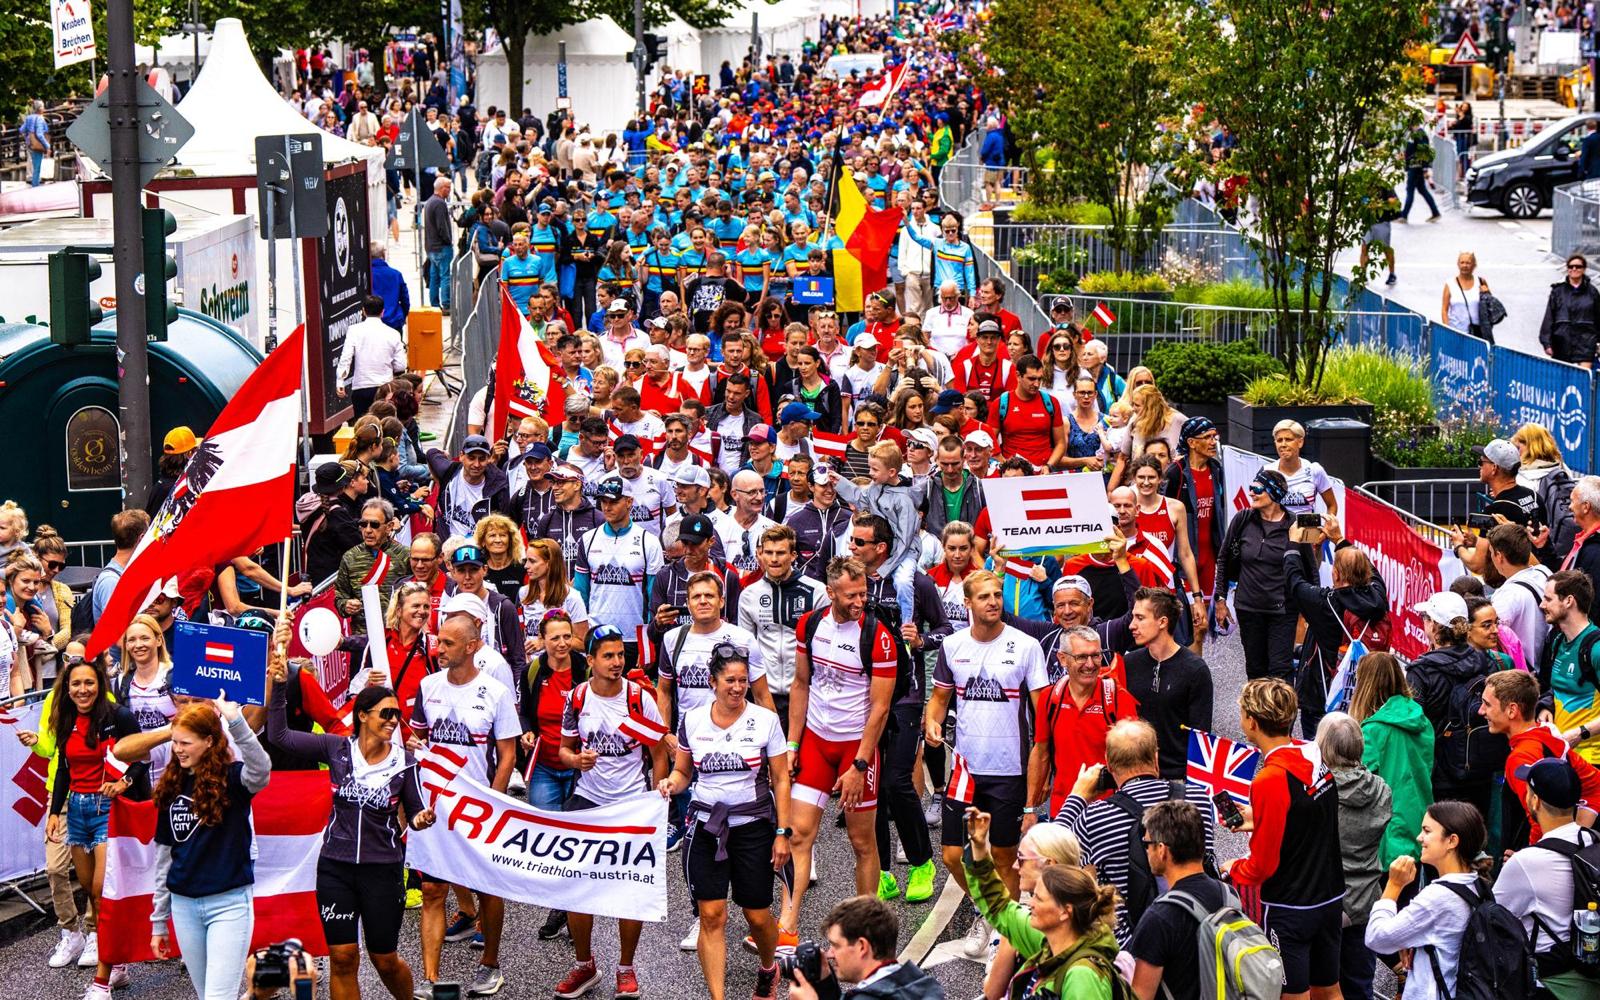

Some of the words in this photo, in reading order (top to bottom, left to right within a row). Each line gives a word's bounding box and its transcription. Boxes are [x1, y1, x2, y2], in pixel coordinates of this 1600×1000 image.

[1197, 508, 1211, 518] AUT
[1002, 527, 1041, 536] TEAM
[1045, 523, 1104, 534] AUSTRIA
[838, 643, 856, 653] JOL
[881, 631, 891, 660] AUT
[195, 666, 242, 682] AUSTRIA
[966, 687, 1001, 699] AUSTRIA
[433, 729, 470, 743] AUSTRIA
[702, 760, 744, 772] AUSTRIA
[867, 764, 875, 791] JOL
[173, 813, 199, 822] ACTIVE
[422, 782, 516, 844] TRI
[174, 822, 190, 831] CITY
[503, 828, 656, 868] AUSTRIA
[492, 852, 655, 885] www.triathlon-austria.at
